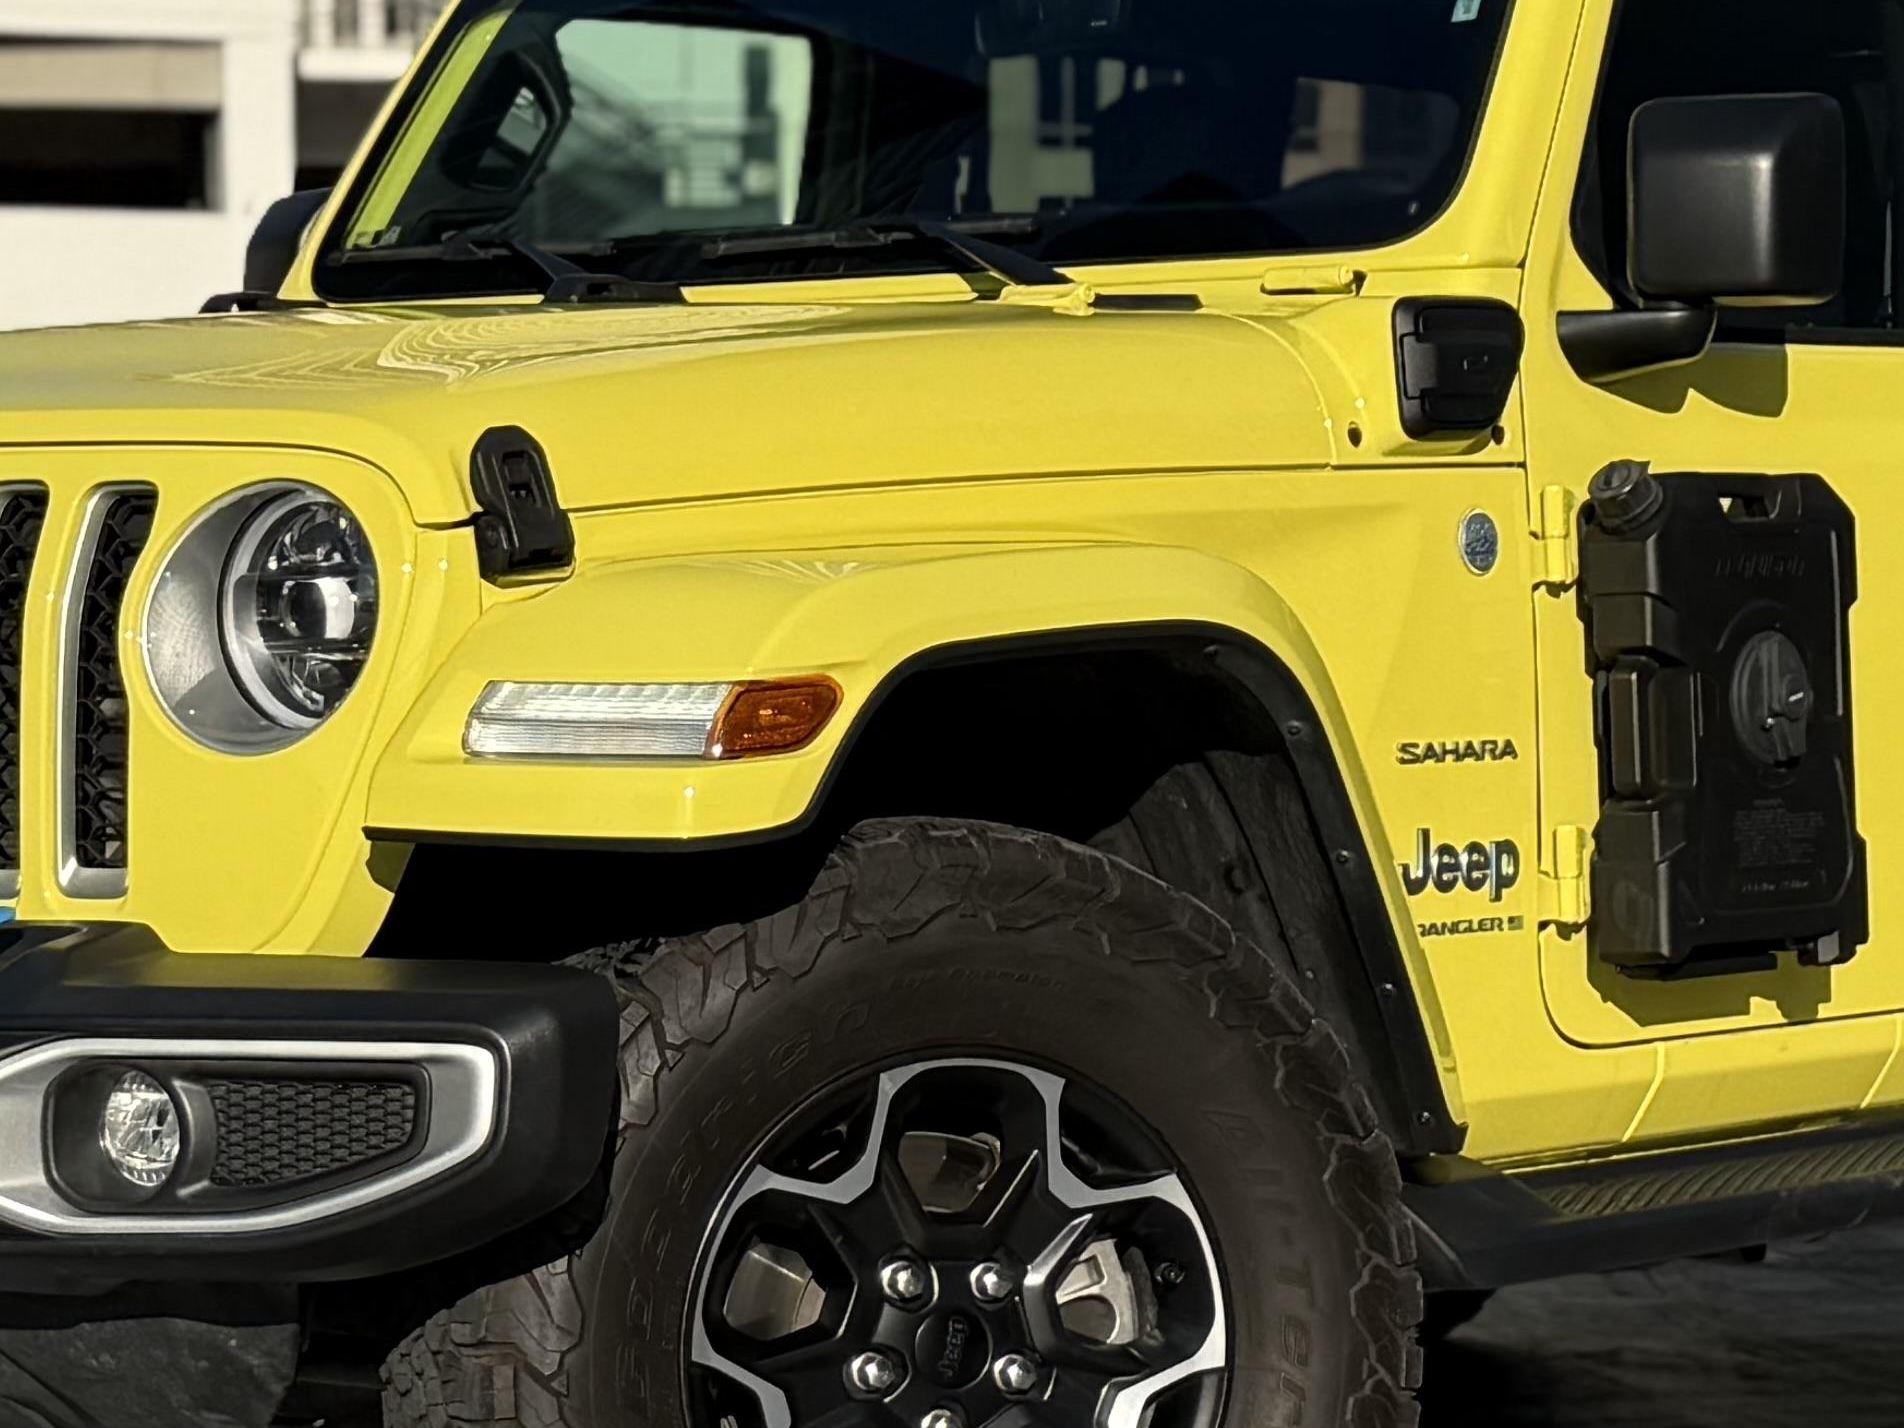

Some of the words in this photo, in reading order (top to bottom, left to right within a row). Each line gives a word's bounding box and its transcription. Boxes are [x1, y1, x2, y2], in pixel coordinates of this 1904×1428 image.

[1396, 739, 1519, 765] SAHARA
[1398, 828, 1520, 903] Jeep
[1417, 916, 1505, 938] RANGLER
